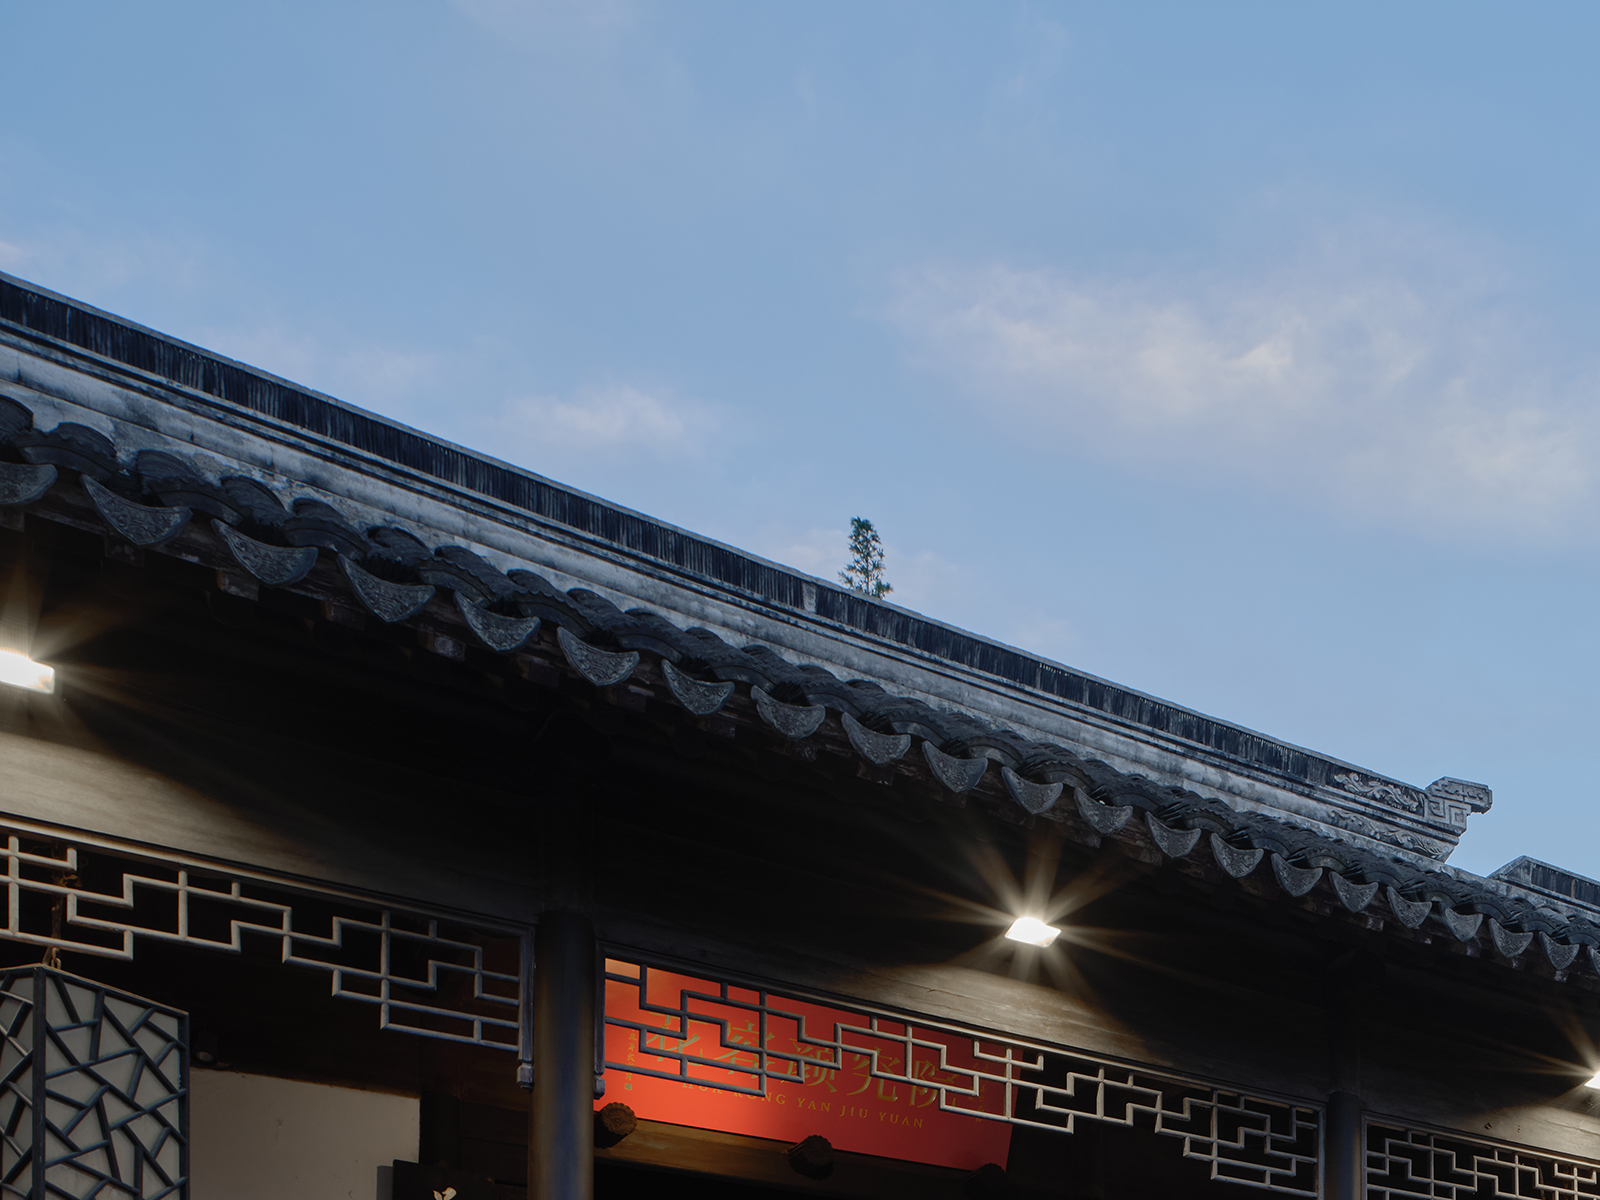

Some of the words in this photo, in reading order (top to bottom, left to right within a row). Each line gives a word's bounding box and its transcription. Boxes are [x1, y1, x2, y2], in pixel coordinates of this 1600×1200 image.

[797, 1097, 830, 1112] YAN
[839, 1105, 868, 1119] JIU
[878, 1111, 923, 1128] YUAN
